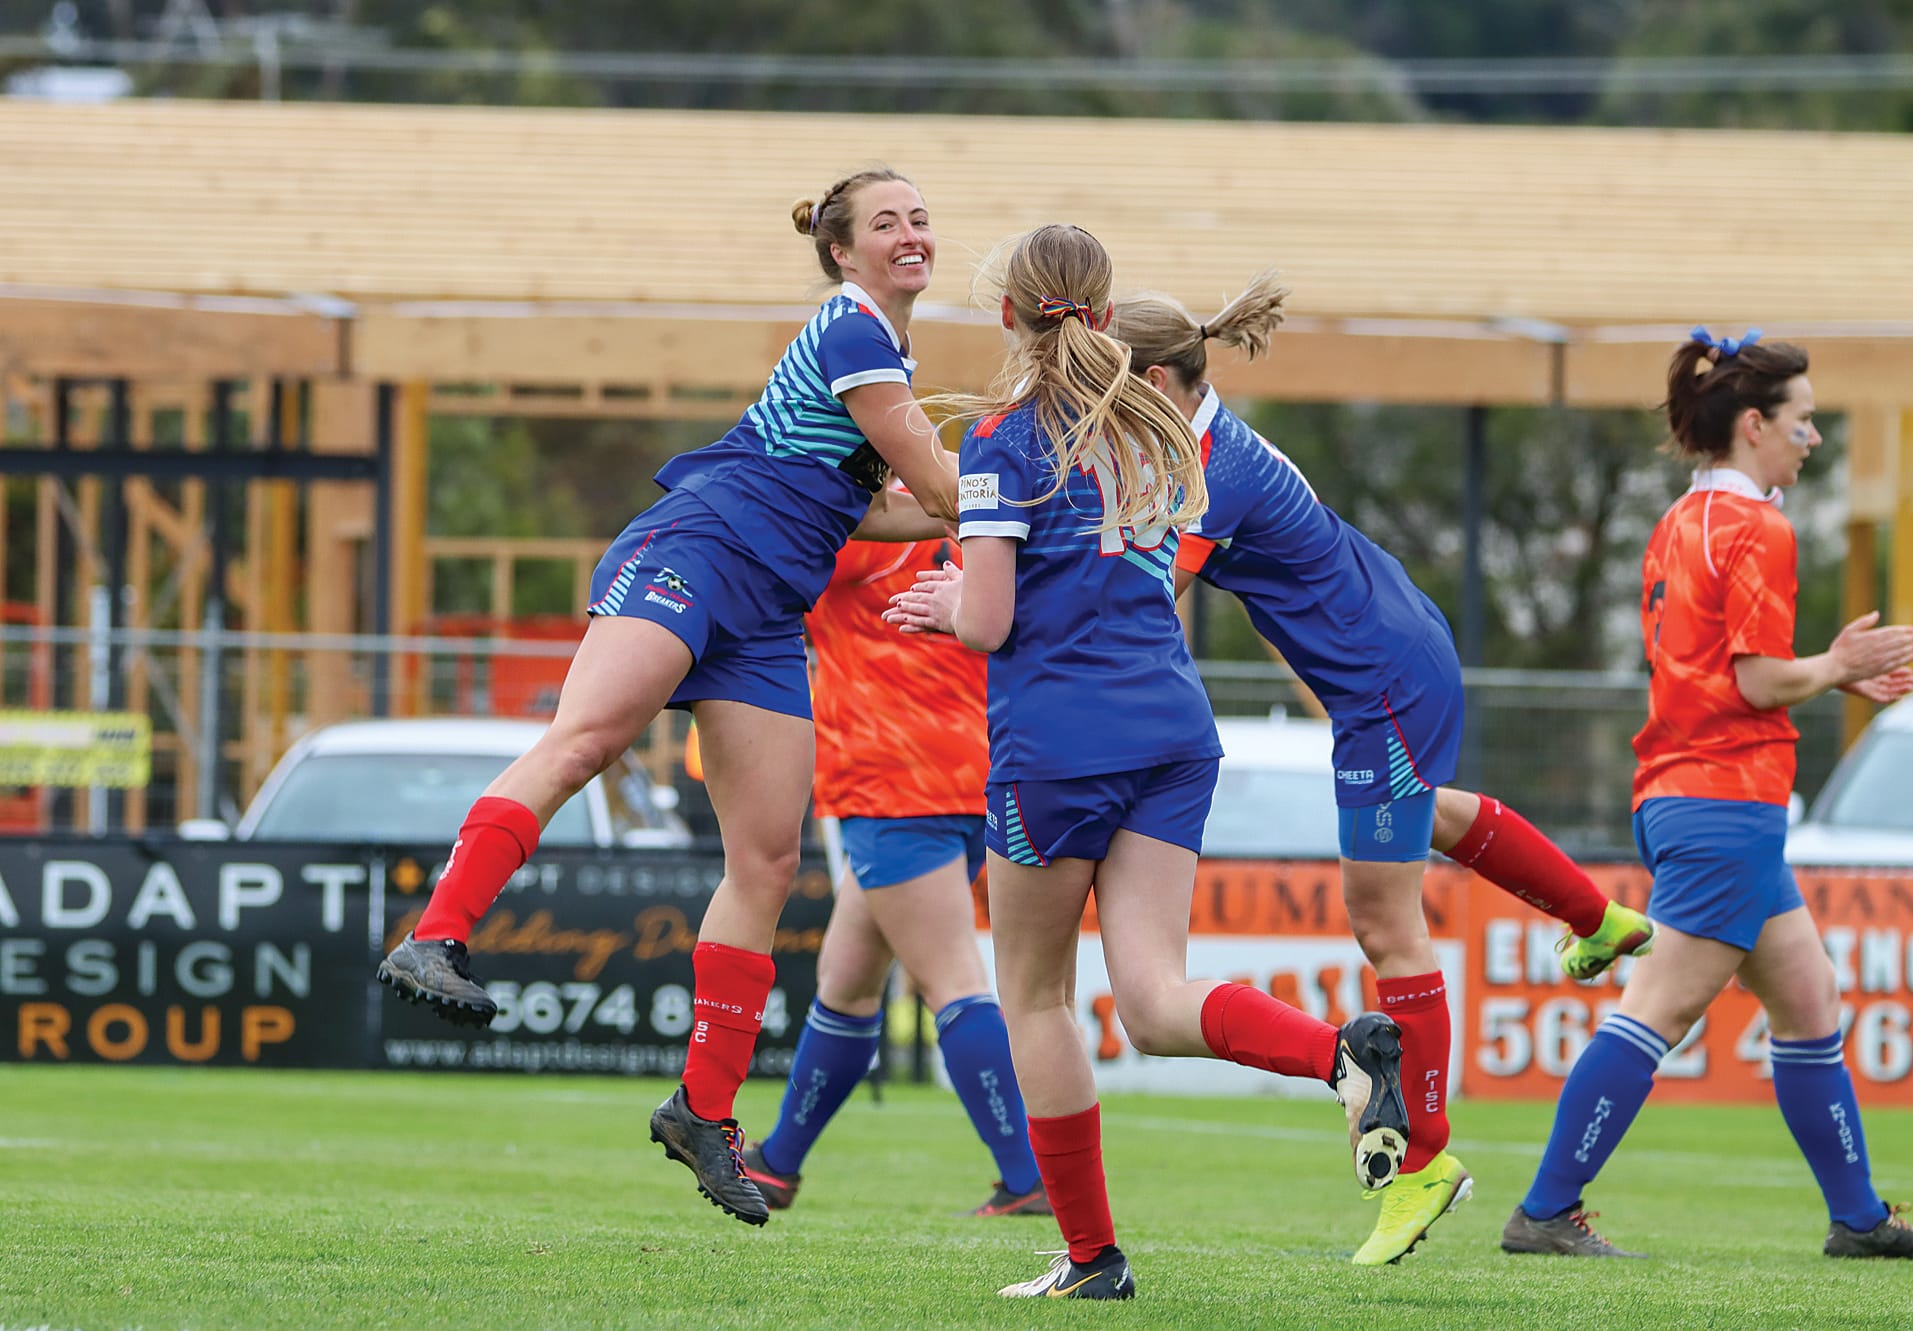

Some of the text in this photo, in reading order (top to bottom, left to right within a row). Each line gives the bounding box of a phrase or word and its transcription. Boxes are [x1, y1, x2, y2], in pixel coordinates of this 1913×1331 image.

[644, 591, 687, 614] BREAKERS
[0, 860, 367, 932] DAPT
[1477, 998, 1707, 1079] 562
